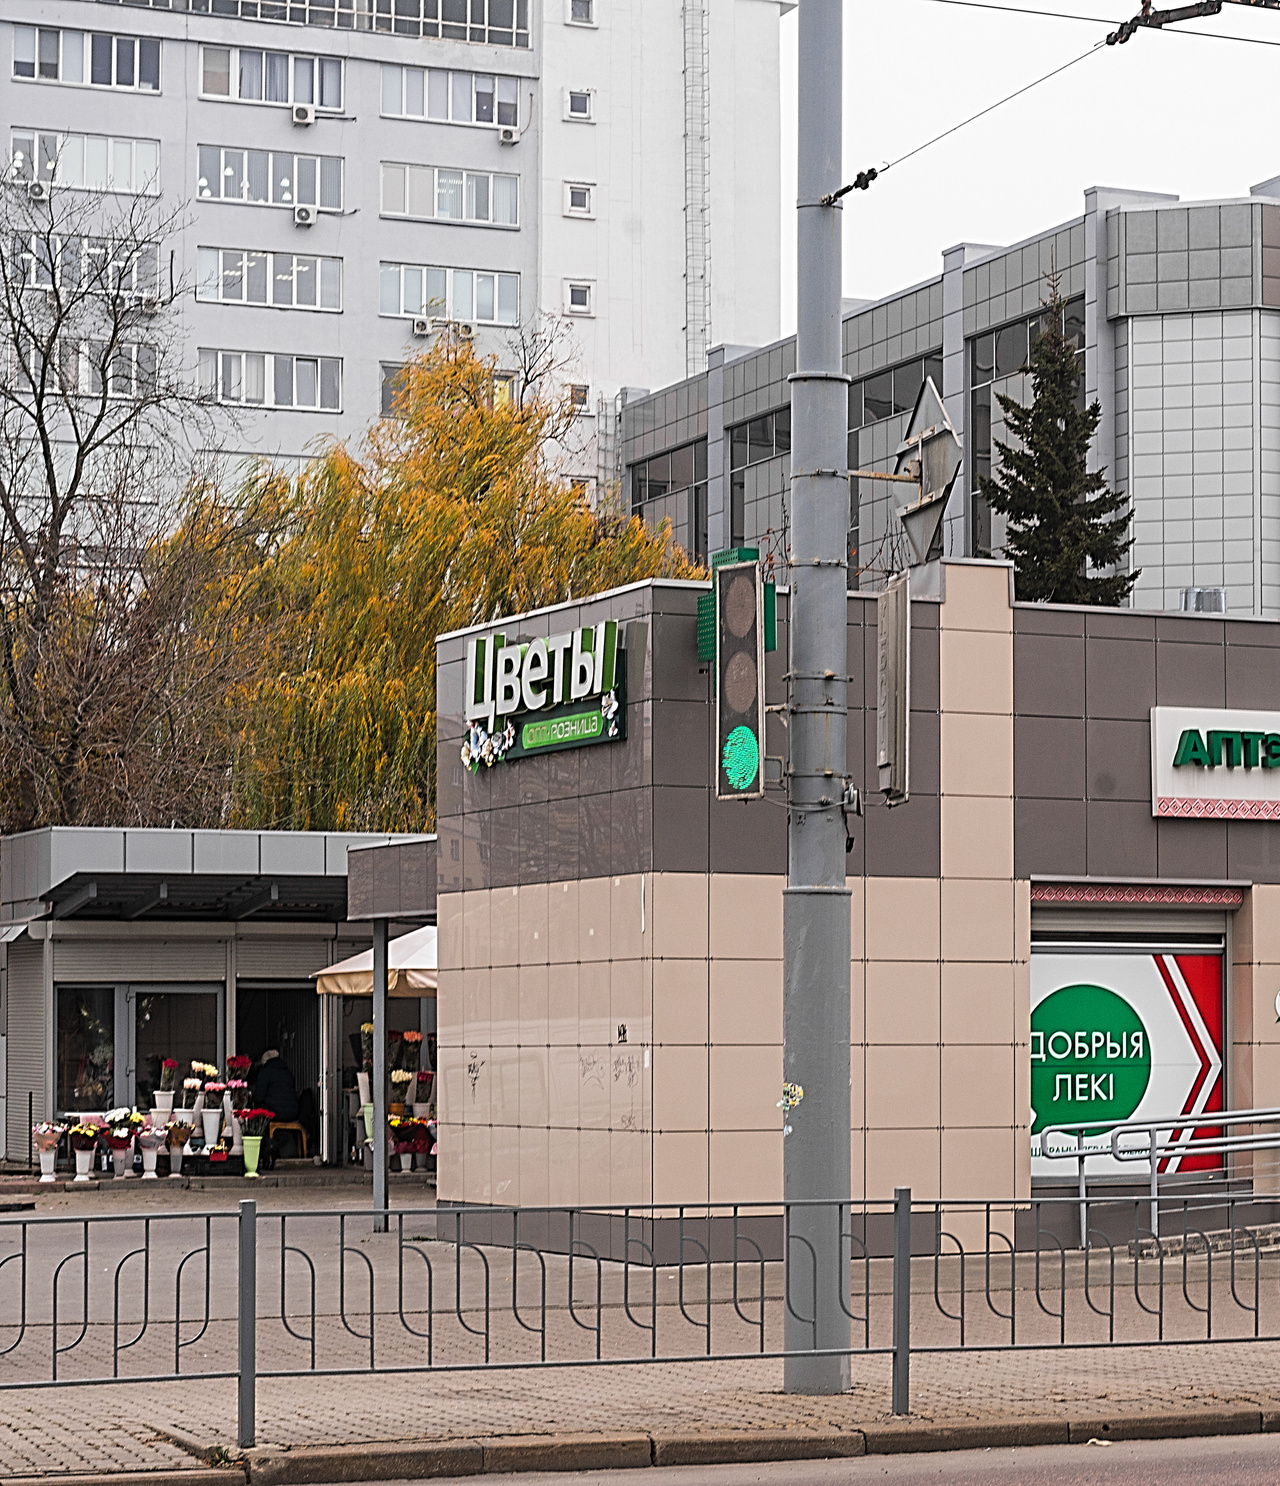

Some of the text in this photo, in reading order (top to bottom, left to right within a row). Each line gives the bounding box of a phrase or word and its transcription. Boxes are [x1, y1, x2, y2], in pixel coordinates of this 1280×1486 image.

[466, 619, 619, 734] Цветы
[1031, 1031, 1144, 1062] ДОБРЫЯ
[1053, 1073, 1114, 1101] ЛЕКІ
